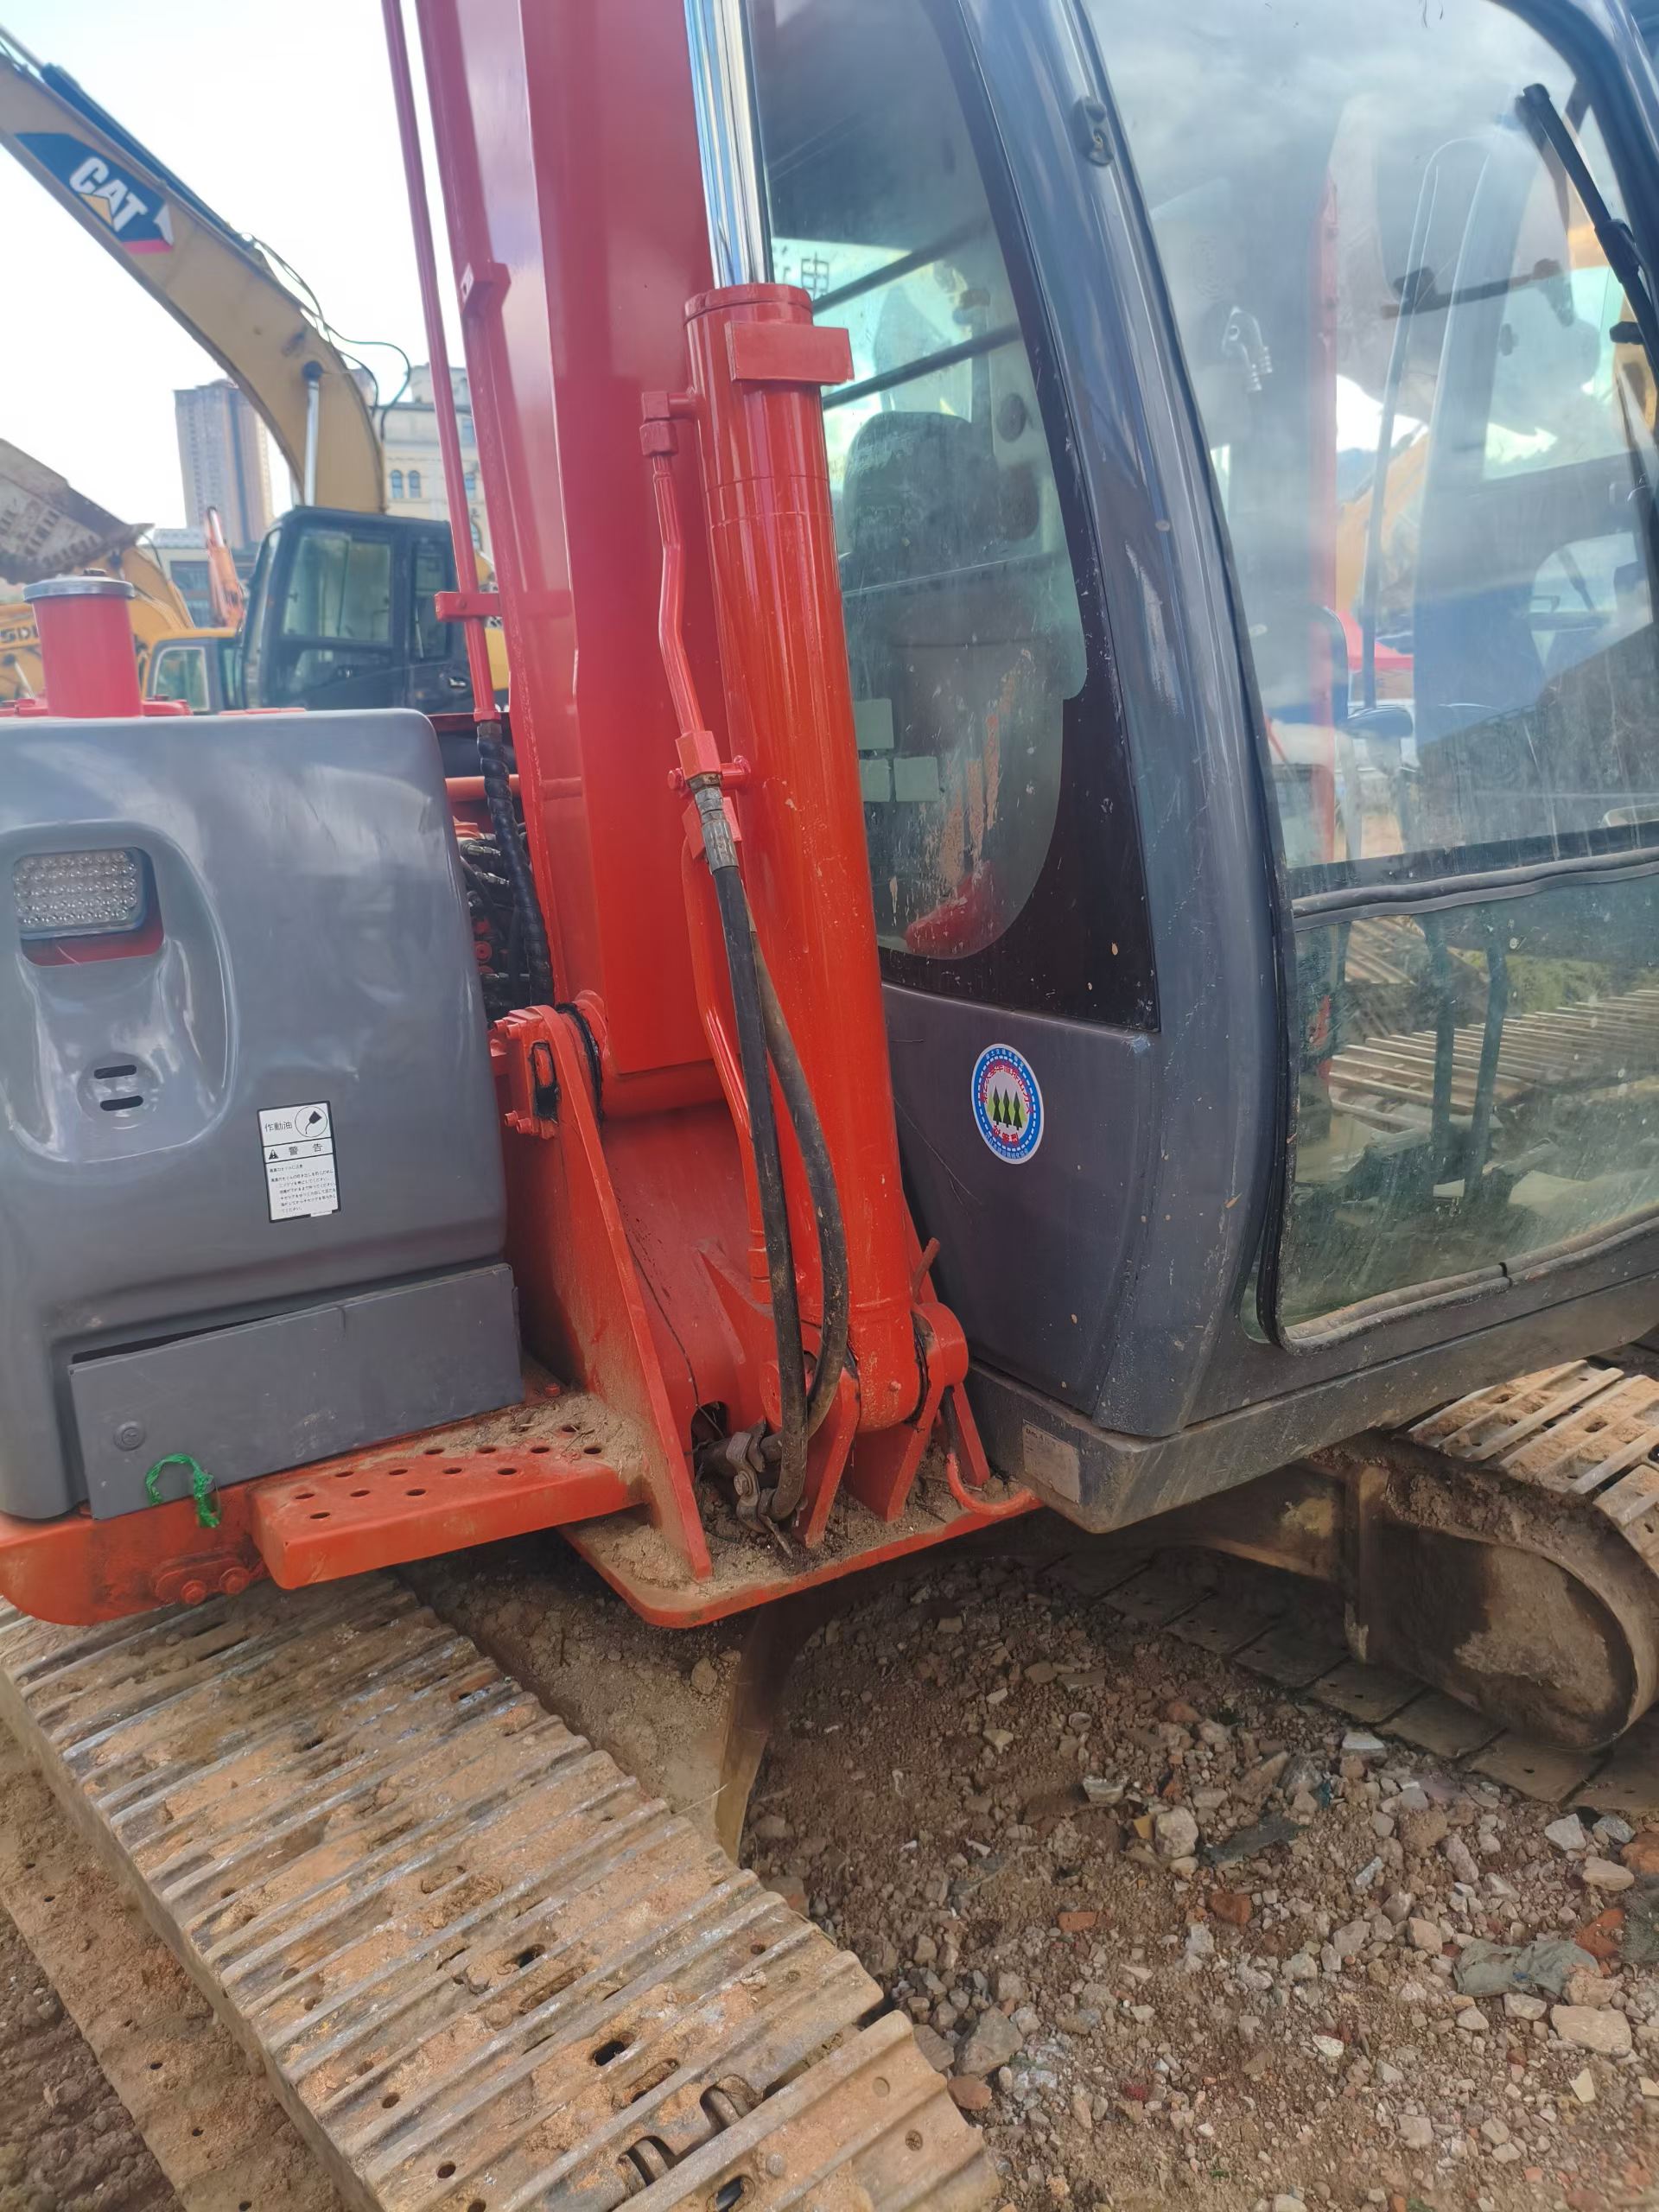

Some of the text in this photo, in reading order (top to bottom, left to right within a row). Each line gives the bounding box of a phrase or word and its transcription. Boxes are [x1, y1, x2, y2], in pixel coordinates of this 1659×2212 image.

[69, 157, 148, 232] CAT
[264, 1121, 293, 1133] 作動油
